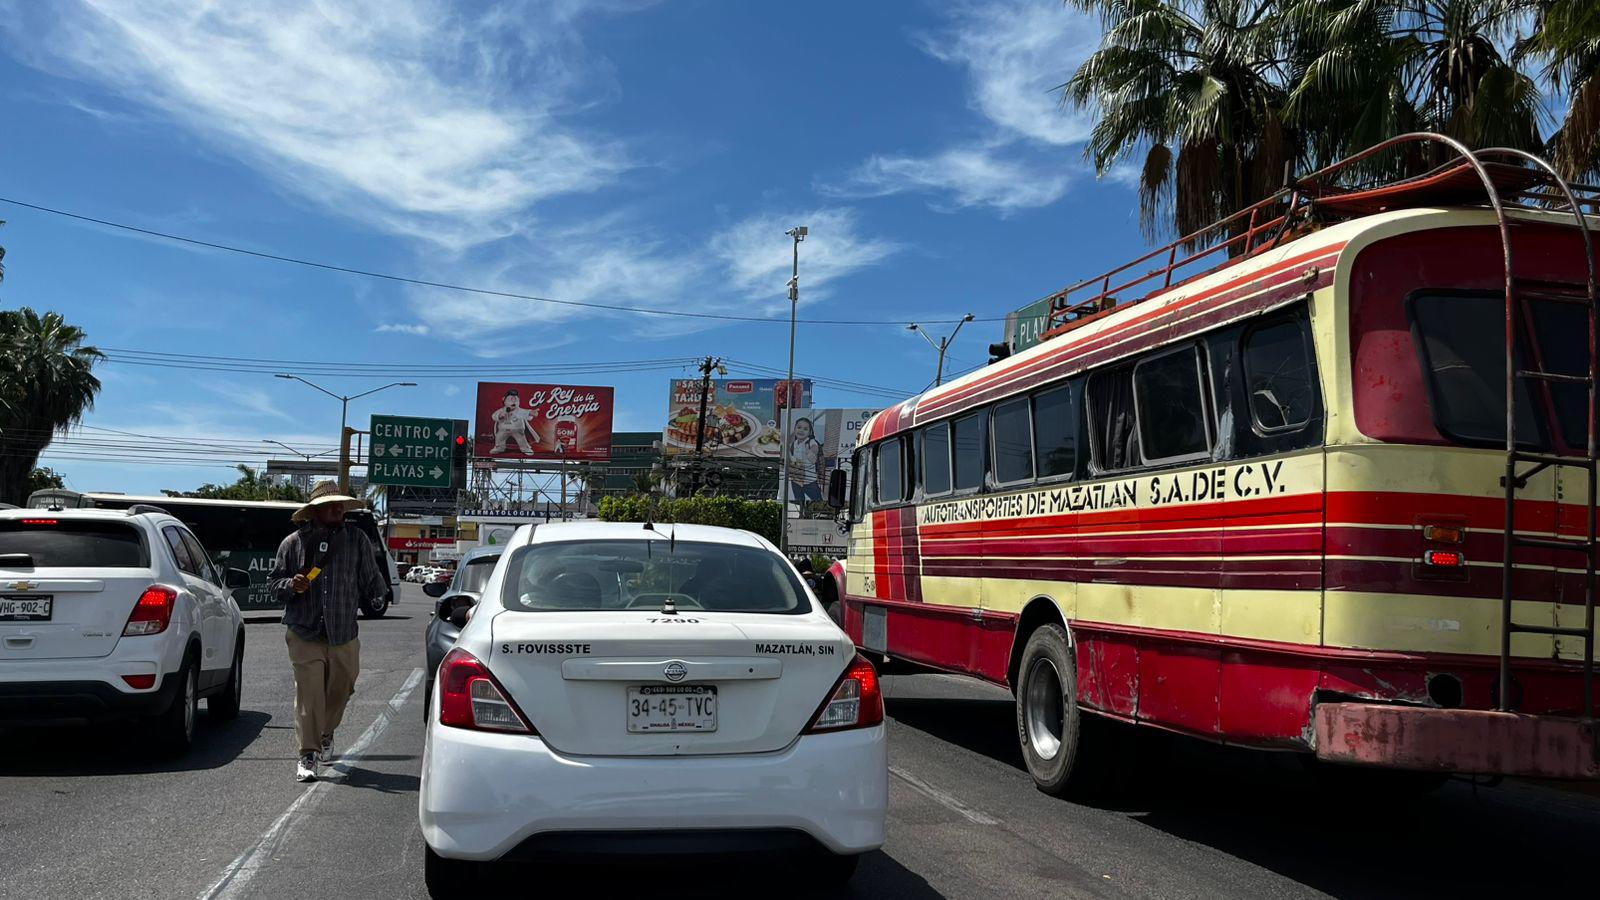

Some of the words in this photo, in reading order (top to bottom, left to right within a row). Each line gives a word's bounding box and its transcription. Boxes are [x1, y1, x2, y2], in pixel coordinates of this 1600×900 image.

[1020, 315, 1046, 345] PLAY
[529, 391, 545, 407] El
[547, 387, 575, 405] Rey
[573, 394, 584, 402] de
[585, 392, 595, 401] la
[375, 423, 431, 440] CENTRO
[405, 445, 449, 460] TEPIC
[373, 463, 424, 479] PLAYAS
[923, 494, 1023, 524] AUTOTRANSPORTES
[1027, 491, 1046, 515] DE
[1050, 480, 1137, 513] MAZATLAN
[1234, 460, 1285, 497] C.V.
[502, 644, 513, 653] S.
[517, 644, 591, 654] FOVISSSTE
[755, 643, 815, 656] MAZATLÁN,
[818, 645, 834, 655] SIN
[632, 697, 712, 717] 34-45-TVC
